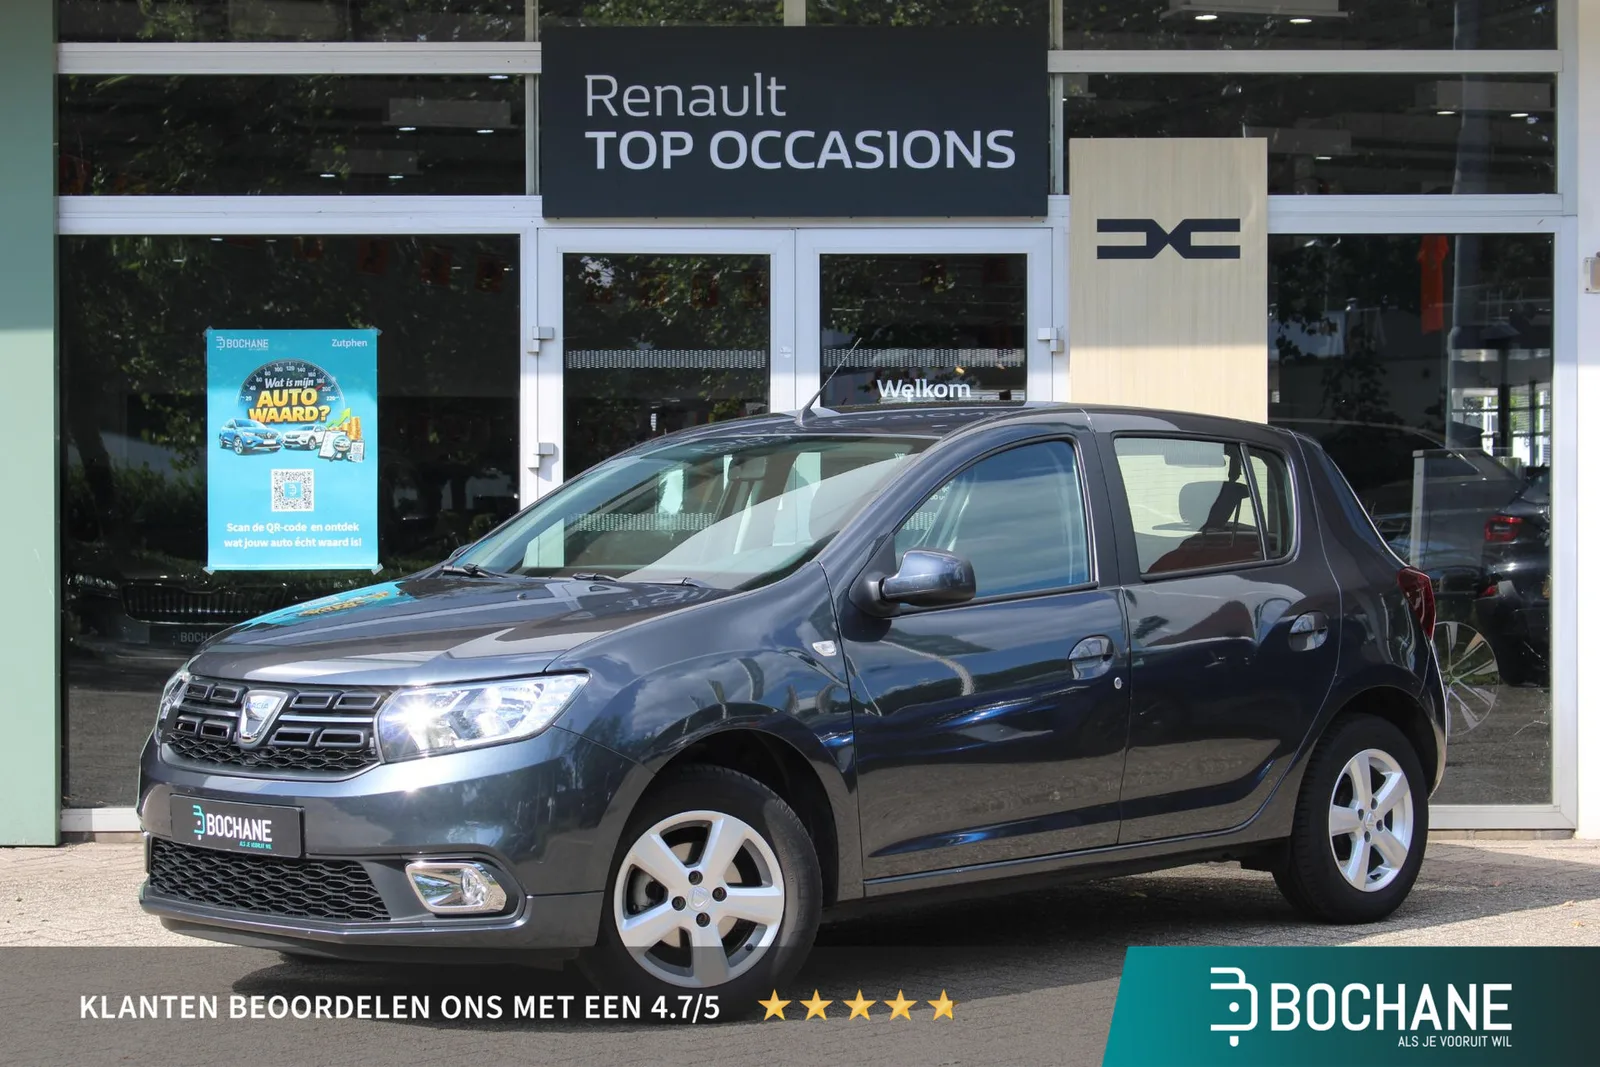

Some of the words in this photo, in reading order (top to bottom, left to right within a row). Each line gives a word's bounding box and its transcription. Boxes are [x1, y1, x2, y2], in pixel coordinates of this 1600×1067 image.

[585, 72, 787, 118] Renault
[585, 131, 694, 170] TOP
[709, 130, 1017, 170] OCCASIONS
[227, 338, 269, 348] BOCHANE
[332, 338, 367, 351] Zutphen
[264, 377, 285, 389] Wat
[286, 377, 294, 386] is
[295, 378, 314, 389] mijn
[876, 378, 972, 398] Welkom
[256, 387, 318, 407] AUTO
[249, 405, 331, 423] WAARD?
[226, 523, 251, 532] Scan
[252, 523, 264, 532] de
[265, 522, 307, 534] QR-code
[310, 524, 322, 532] en
[324, 522, 359, 532] ontdek
[224, 539, 243, 547] wat
[243, 538, 269, 549] jouw
[270, 539, 293, 547] auto
[295, 536, 317, 547] écht
[318, 538, 349, 547] waard
[206, 813, 273, 843] BOCHANE
